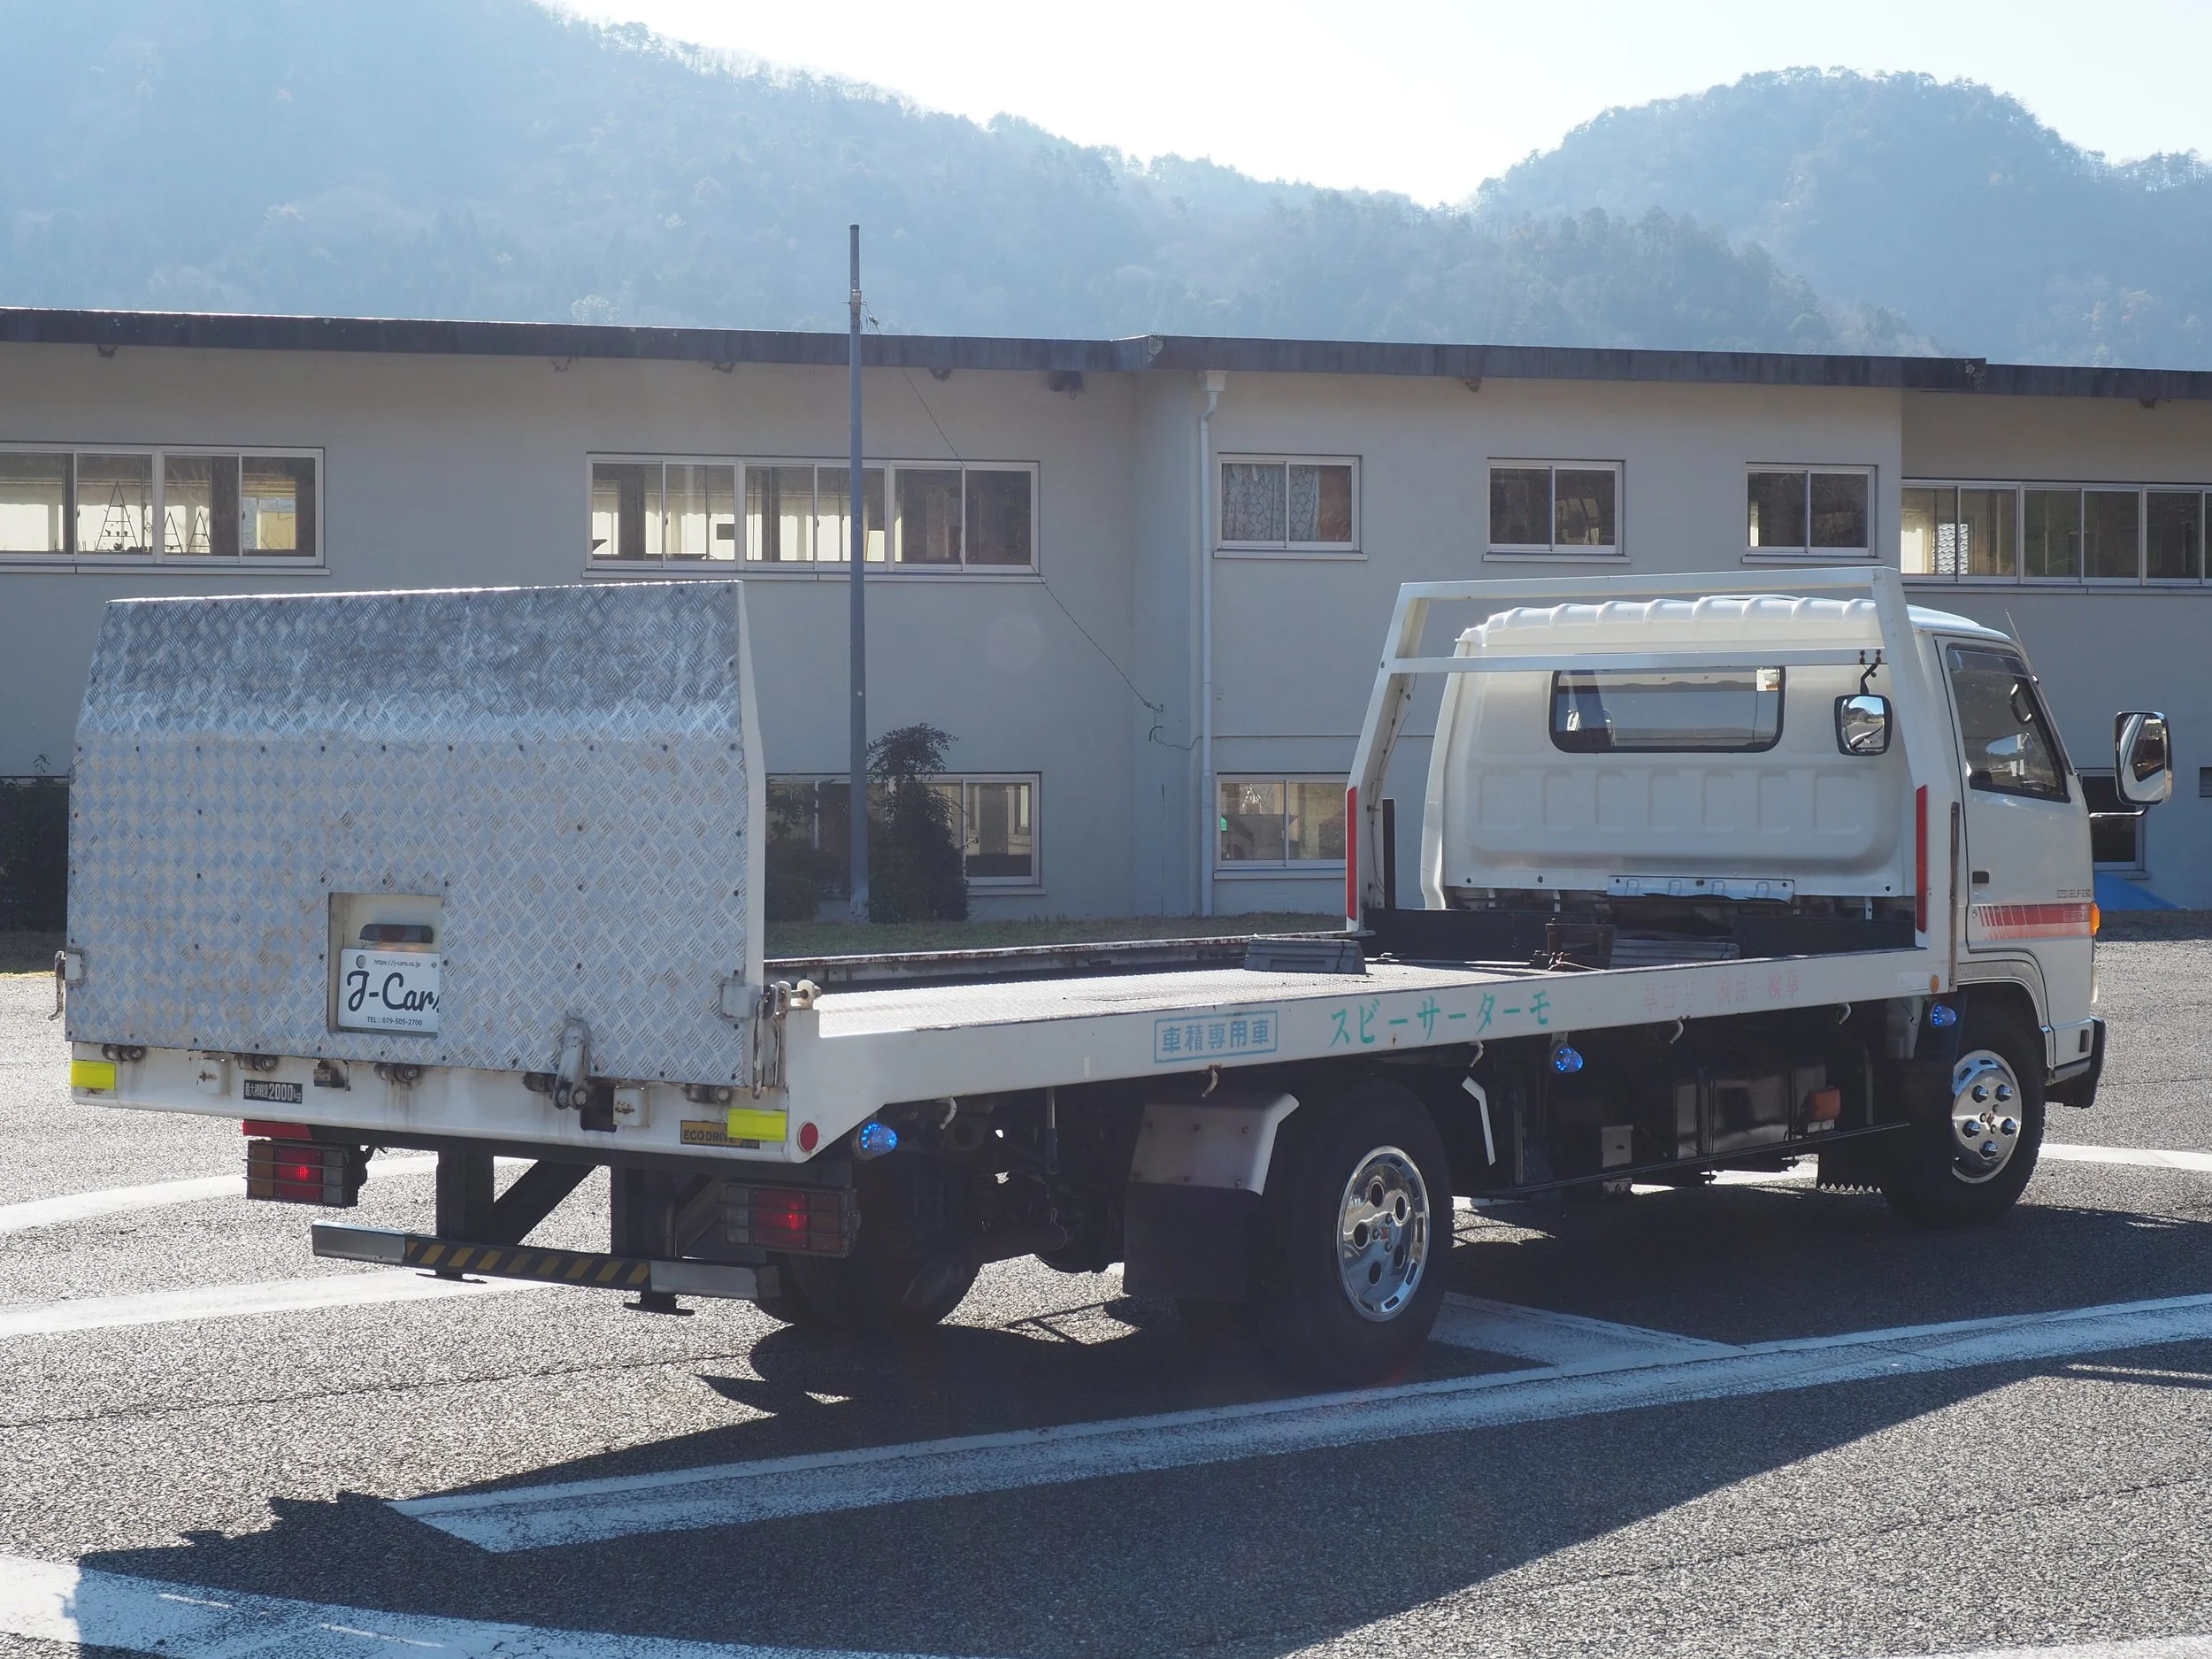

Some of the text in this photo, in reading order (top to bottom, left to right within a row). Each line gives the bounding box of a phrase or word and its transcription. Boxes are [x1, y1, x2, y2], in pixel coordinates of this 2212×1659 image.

[373, 958, 421, 968] https://j-cars.co.jp
[382, 1017, 423, 1026] 079-505-2700
[1162, 1018, 1270, 1053] 車積専用車
